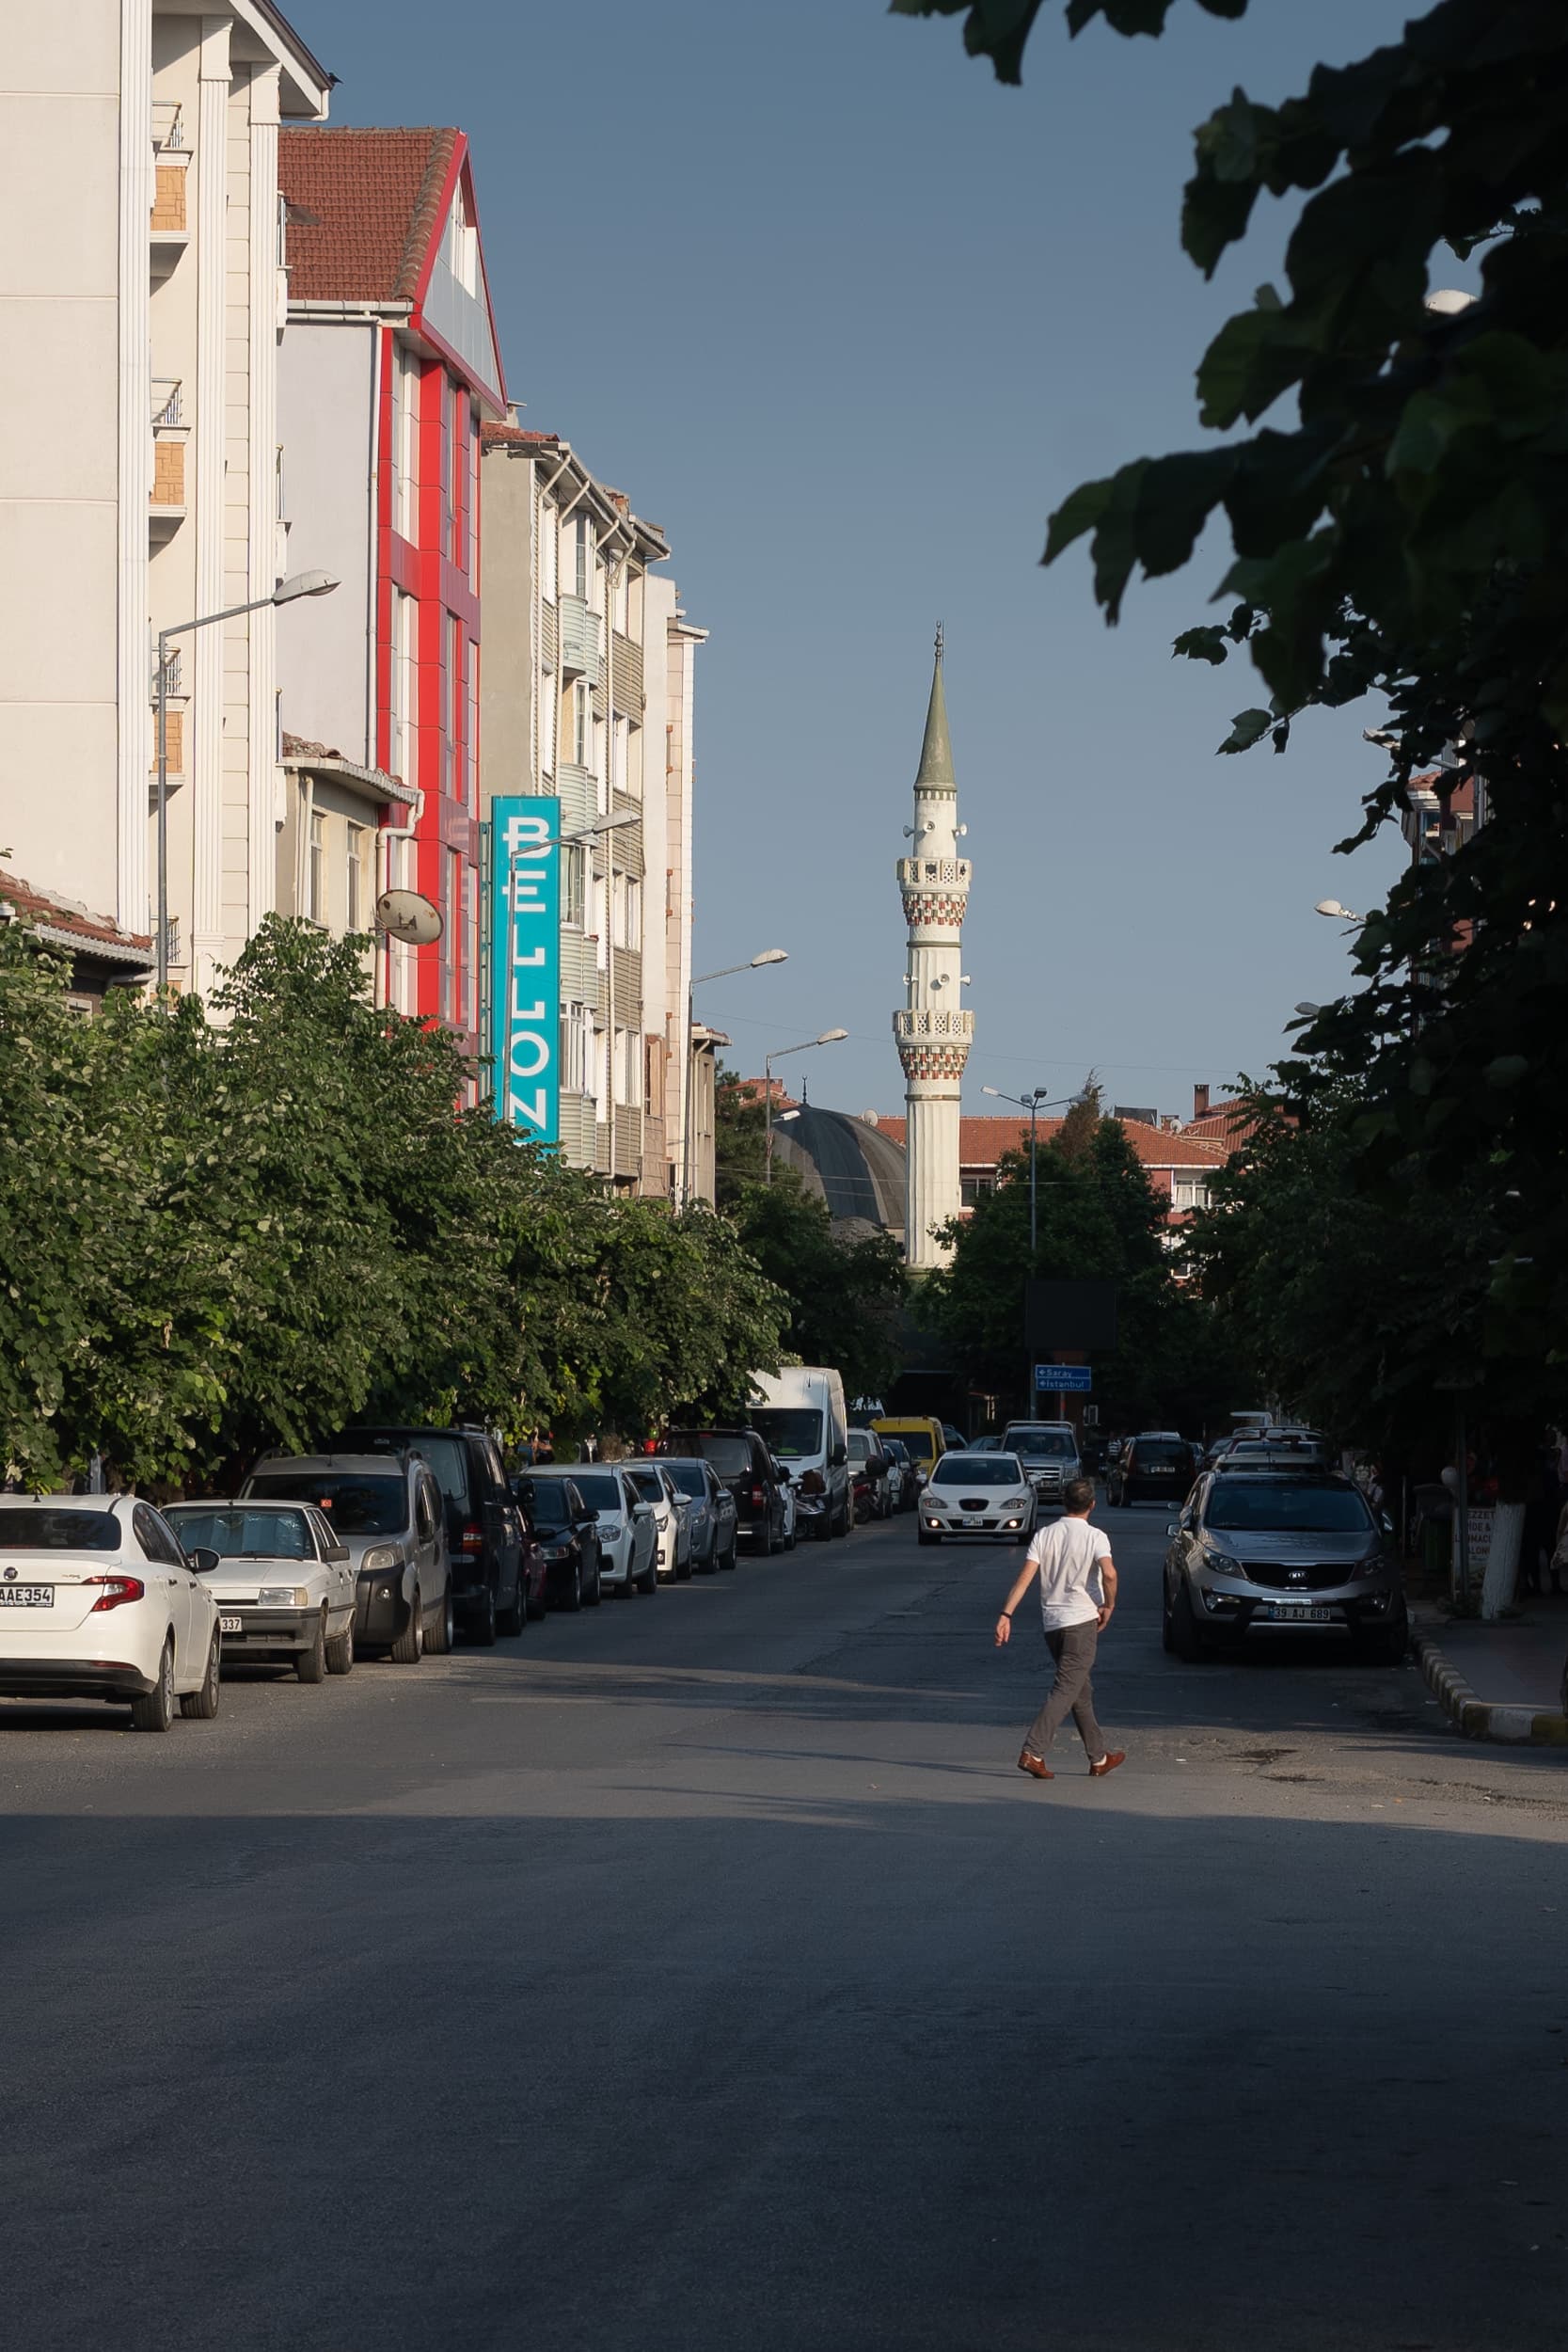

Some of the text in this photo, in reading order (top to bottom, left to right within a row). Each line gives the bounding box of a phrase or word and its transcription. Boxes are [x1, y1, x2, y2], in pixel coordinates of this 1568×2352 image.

[501, 816, 552, 1148] BELLON
[1047, 1369, 1072, 1378] Saray
[1467, 1511, 1496, 1519] EZZET
[0, 1588, 51, 1602] AAE354
[1275, 1608, 1329, 1619] 39 AJ 689
[222, 1619, 240, 1629] 337
